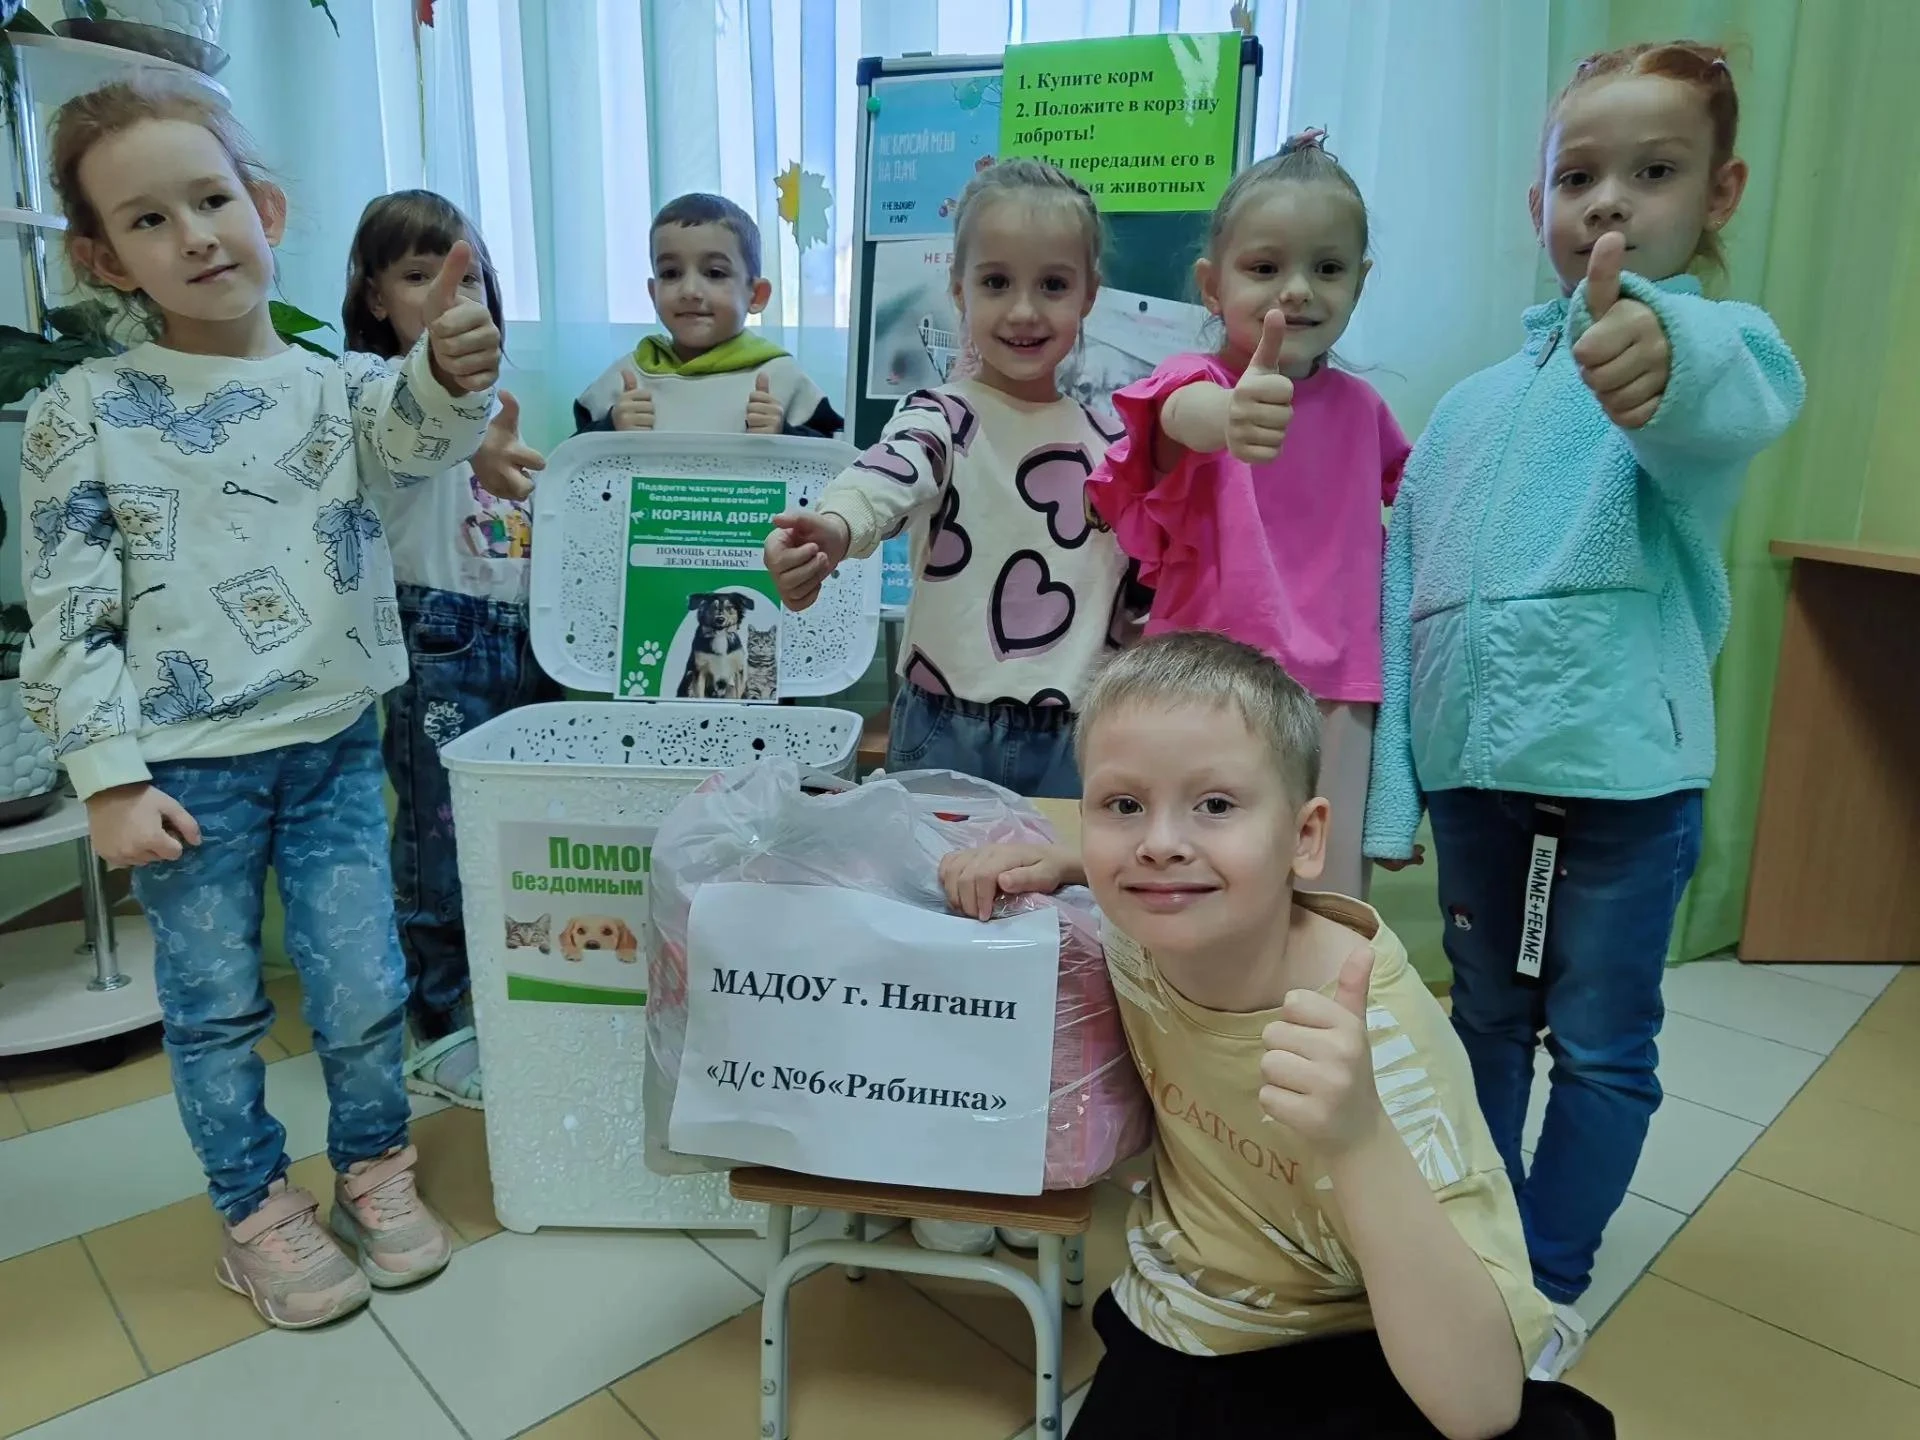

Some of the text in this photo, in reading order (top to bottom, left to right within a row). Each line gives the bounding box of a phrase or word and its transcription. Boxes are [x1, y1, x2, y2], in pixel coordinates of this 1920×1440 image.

[1018, 70, 1154, 91] 1. Купите корм
[1016, 103, 1030, 118] 2.
[1034, 100, 1124, 117] Положите
[1129, 101, 1139, 112] в
[1013, 124, 1095, 146] доброты!
[1070, 154, 1164, 172] передадим
[1171, 154, 1198, 168] его
[1204, 154, 1215, 166] в
[1110, 179, 1206, 194] животных
[924, 253, 941, 264] НЕ
[637, 482, 781, 496] Подарите частичку доброты
[649, 494, 710, 504] бездомным
[652, 509, 723, 522] КОРЗИНА
[656, 547, 705, 557] ПОМОЩЬ
[707, 548, 752, 558] СЛАБЫМ
[664, 557, 749, 568] ДЕЛО СИЛЬНЫХ!
[512, 870, 644, 896] бездомным
[1522, 847, 1552, 964] HOMME+FEMME
[711, 967, 1018, 1020] МАДОУ г. Нягани
[706, 1059, 765, 1092] «Д/с
